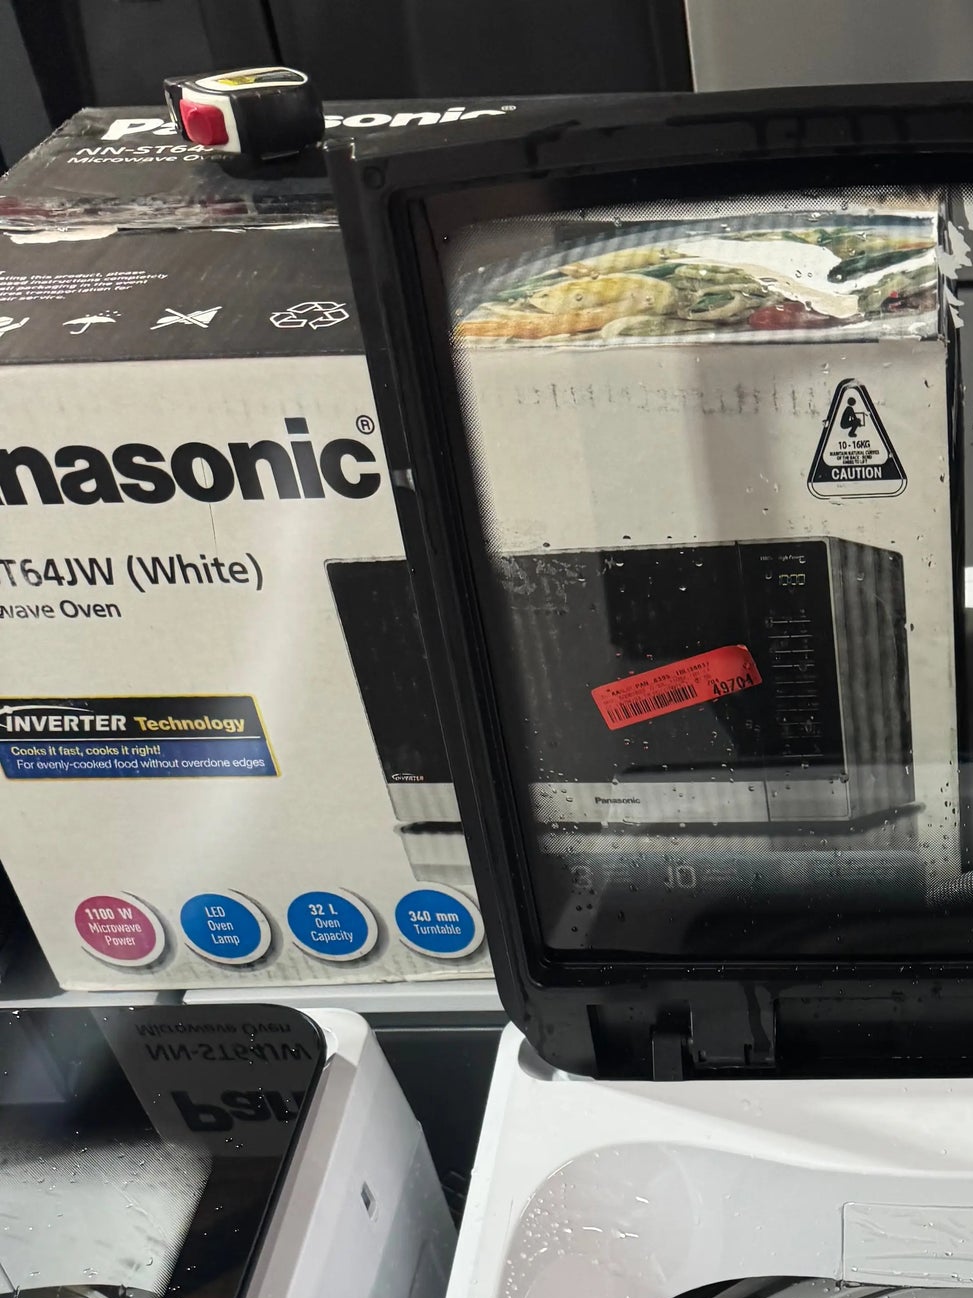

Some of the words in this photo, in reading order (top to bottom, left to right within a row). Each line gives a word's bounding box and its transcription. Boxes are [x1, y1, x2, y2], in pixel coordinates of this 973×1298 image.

[67, 155, 178, 164] Microwave
[832, 467, 882, 480] CAUTION
[127, 553, 263, 593] (White)
[60, 600, 121, 618] Oven
[6, 715, 126, 732] INVERTER
[133, 716, 245, 733] Technology
[11, 746, 46, 756] Cooks
[49, 746, 58, 755] it
[59, 746, 84, 757] fast,
[85, 745, 119, 755] cooks
[121, 745, 130, 755] it
[131, 745, 161, 756] right!
[17, 759, 34, 770] For
[114, 759, 139, 769] food
[142, 758, 180, 769] without
[181, 758, 230, 768] overdone
[232, 758, 265, 769] edges
[85, 908, 114, 920] 1100
[119, 908, 133, 920] W
[205, 906, 225, 918] LED
[309, 904, 324, 915] 32
[331, 904, 338, 915] L
[408, 911, 430, 922] 340
[436, 912, 459, 922] mm
[88, 922, 142, 934] Microwave
[207, 920, 234, 931] Oven
[315, 918, 340, 928] Oven
[414, 924, 461, 935] Turntable
[105, 935, 136, 946] Power
[211, 934, 240, 946] Lamp
[310, 931, 353, 943] Capacity
